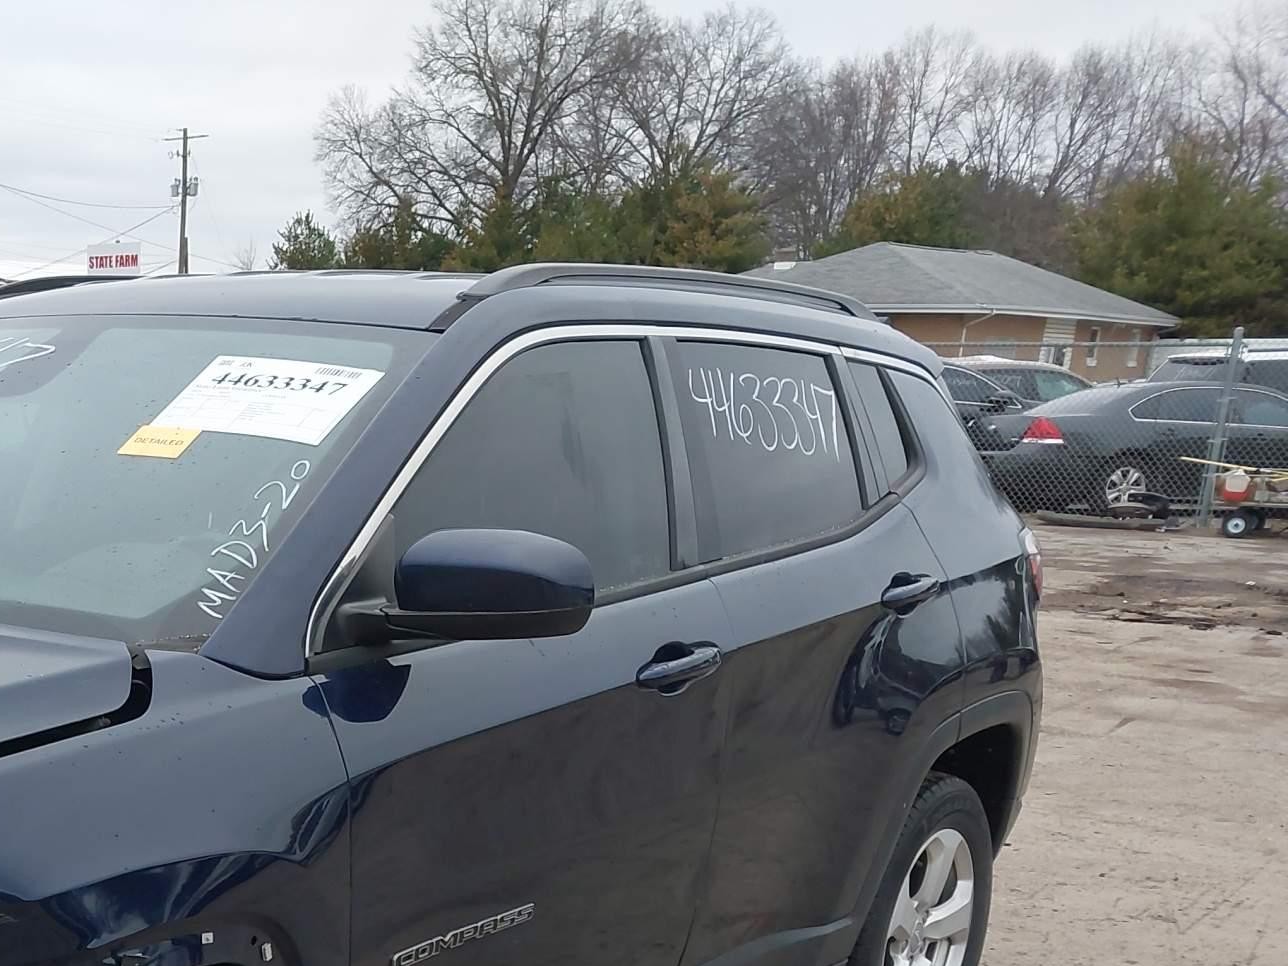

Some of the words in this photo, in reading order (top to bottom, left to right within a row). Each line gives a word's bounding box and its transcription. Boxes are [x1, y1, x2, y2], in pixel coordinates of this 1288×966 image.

[88, 255, 113, 269] STATE
[114, 253, 138, 268] FARM
[212, 372, 349, 396] 44633347
[688, 367, 840, 463] 44633347
